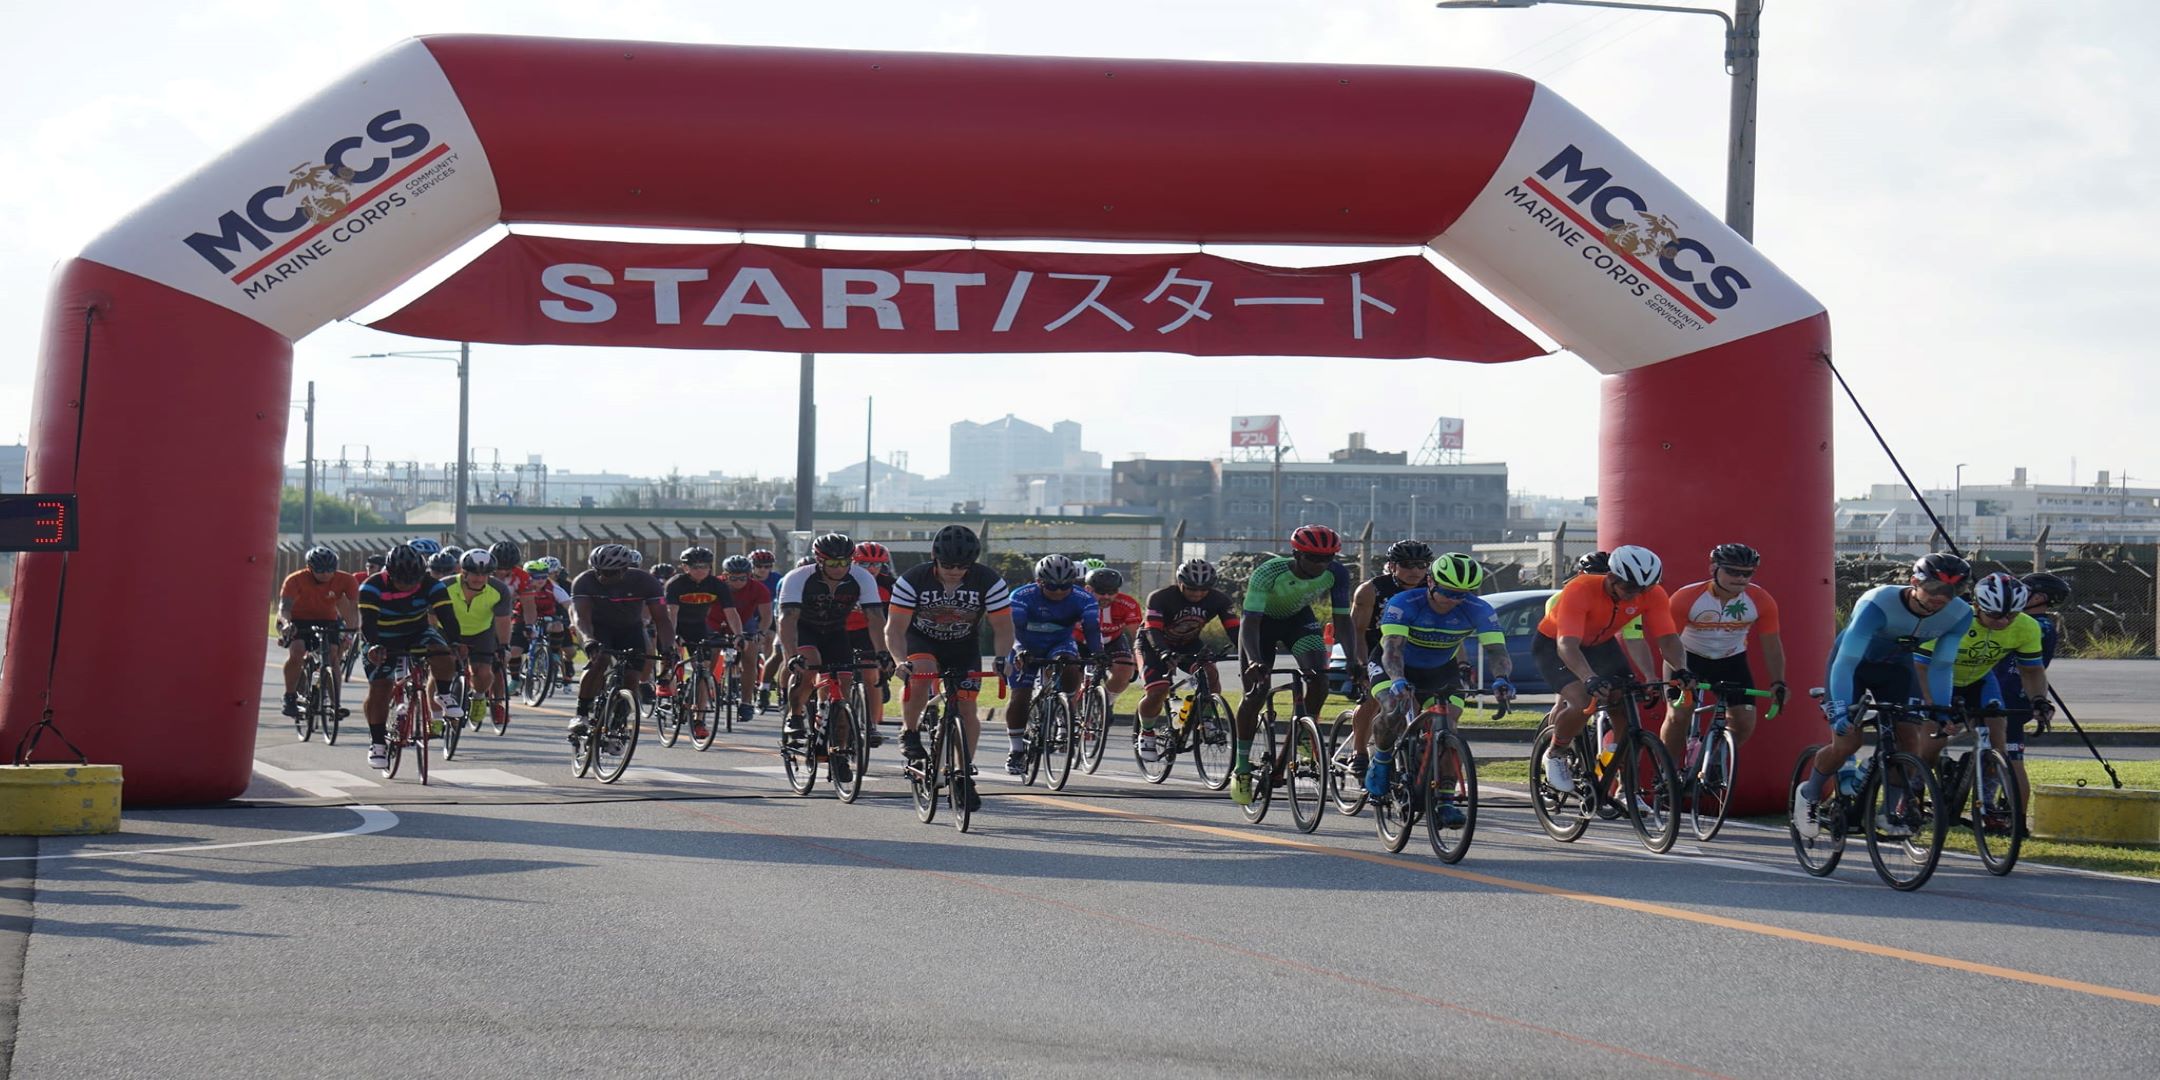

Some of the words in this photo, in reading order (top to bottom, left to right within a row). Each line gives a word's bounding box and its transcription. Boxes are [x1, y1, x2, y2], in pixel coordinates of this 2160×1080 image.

[405, 152, 460, 191] COMMUNITY
[411, 167, 456, 198] SERVICES
[182, 109, 430, 274] MCCS
[243, 239, 332, 300] MARINE
[332, 192, 407, 243] CORPS
[1505, 185, 1585, 247] MARINE
[1582, 245, 1650, 297] CORPS
[1535, 144, 1752, 310] MCCS
[1644, 299, 1686, 331] SERVICES
[1653, 293, 1704, 332] COMMUNITY
[1240, 432, 1268, 445] アコム
[35, 502, 64, 543] 3
[920, 590, 980, 605] SLOTH
